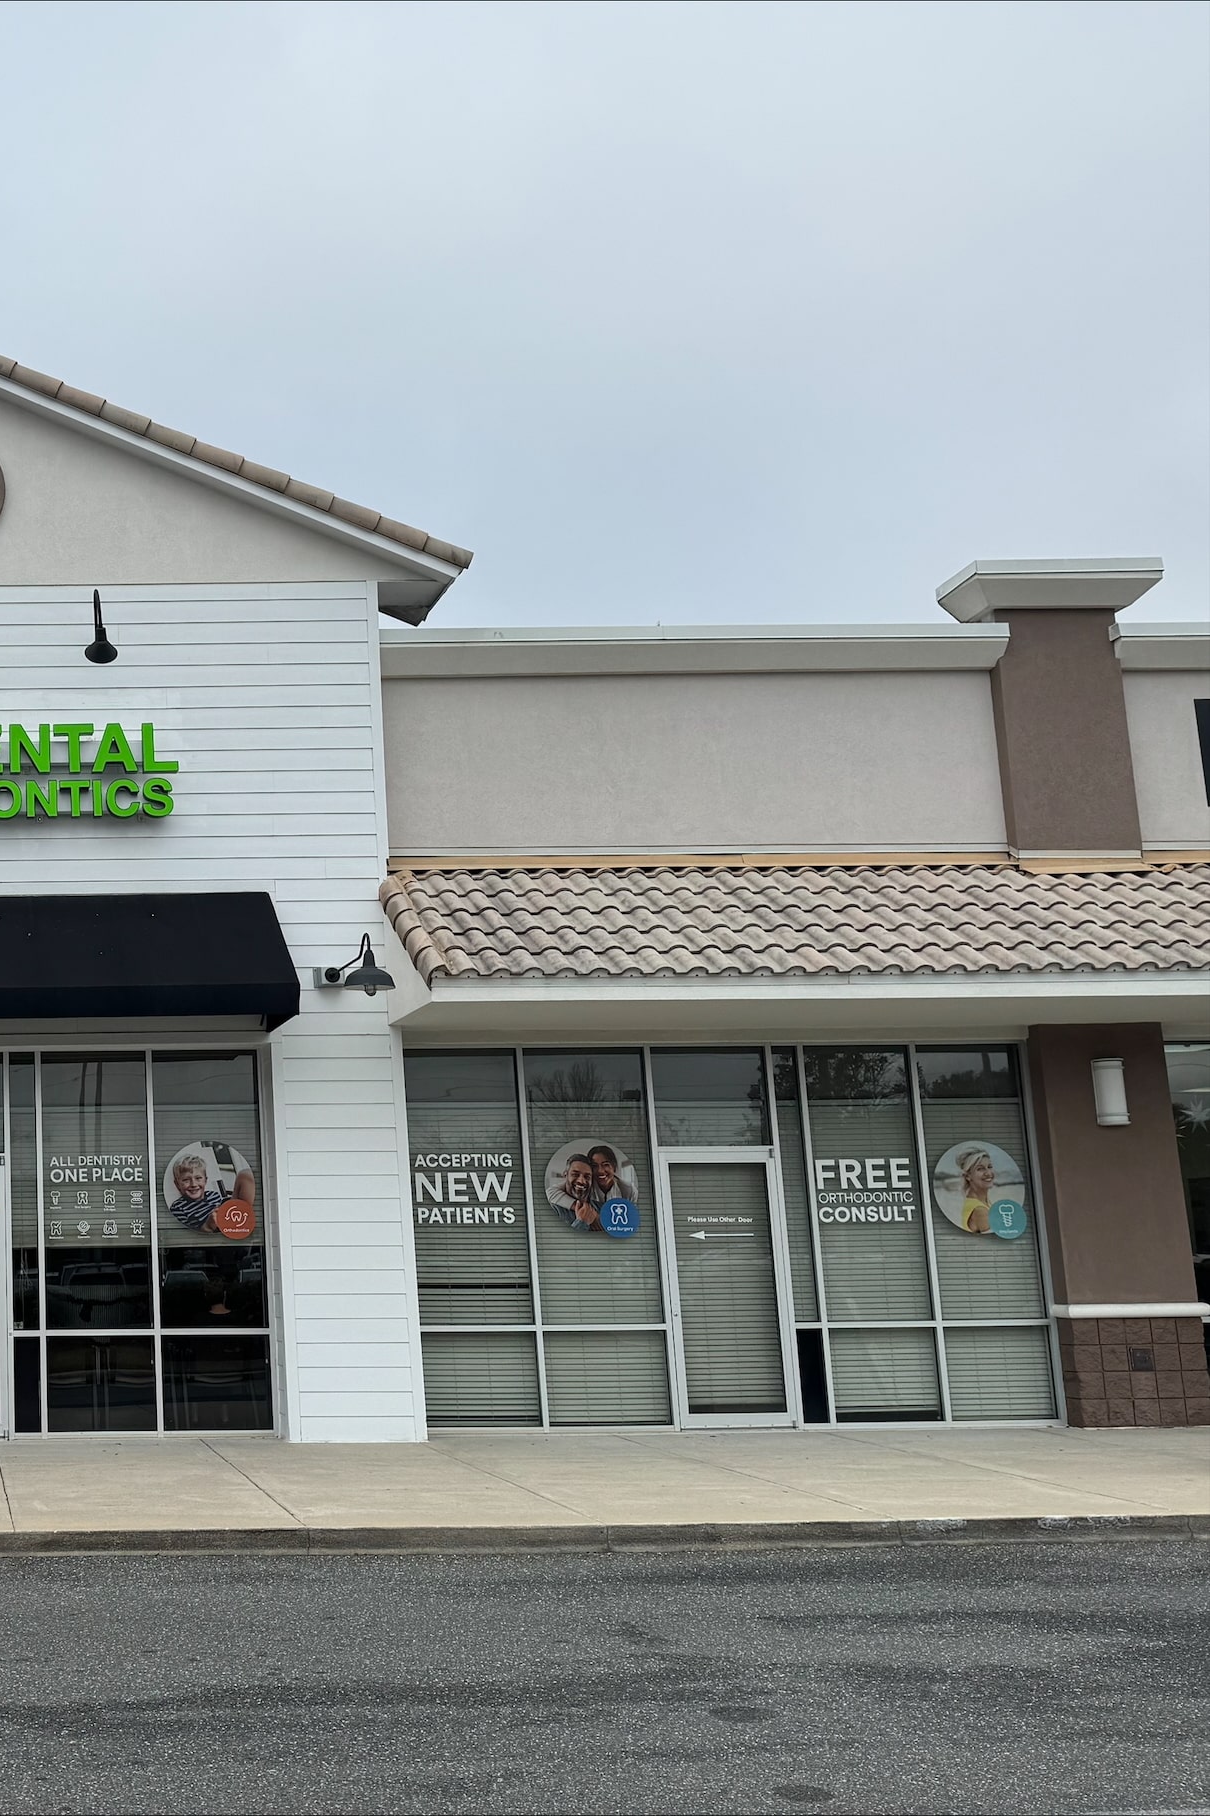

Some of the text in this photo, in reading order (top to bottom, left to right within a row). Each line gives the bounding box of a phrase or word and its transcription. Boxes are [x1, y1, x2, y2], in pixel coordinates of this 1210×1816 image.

[50, 1155, 142, 1167] ALL DENTISTRY
[414, 1153, 513, 1168] ACCEPTING
[50, 1167, 143, 1183] ONE PLACE
[815, 1158, 912, 1190] FREE
[415, 1172, 513, 1202] NEW
[818, 1191, 914, 1204] ORTHODONTIC
[417, 1207, 516, 1224] PATIENTS
[818, 1205, 916, 1223] CONSULT
